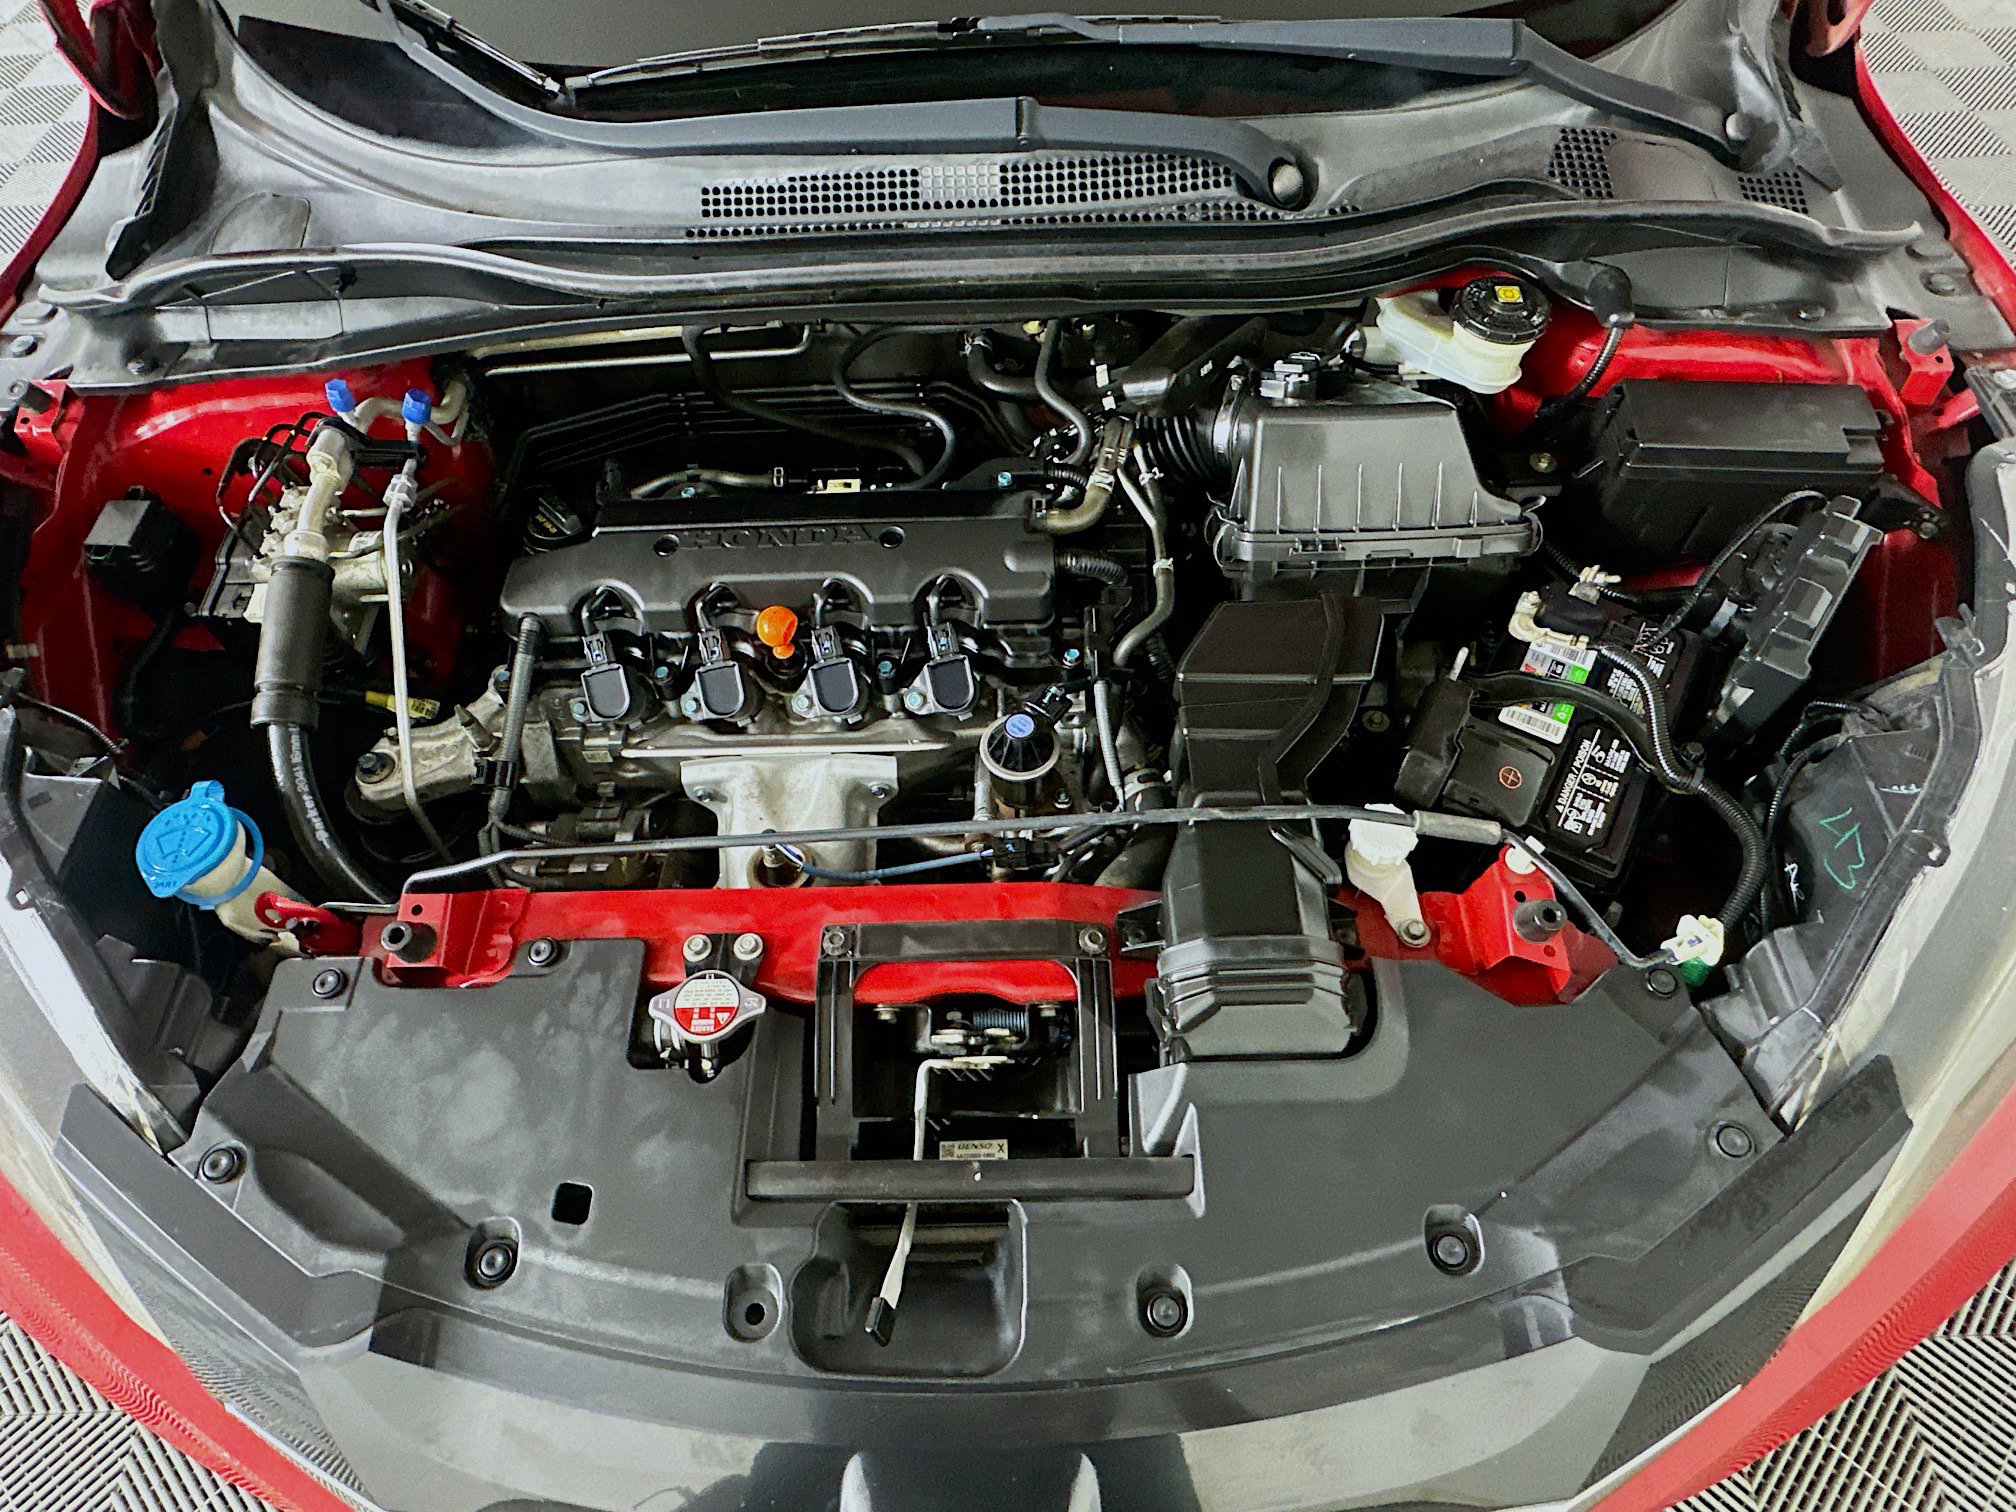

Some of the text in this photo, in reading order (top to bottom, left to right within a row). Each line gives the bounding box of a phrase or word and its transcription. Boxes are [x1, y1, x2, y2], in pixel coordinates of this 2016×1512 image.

[680, 524, 878, 551] HONDA
[1557, 772, 1578, 806] DANGER
[1573, 738, 1592, 769] POISON
[997, 1142, 1005, 1154] X
